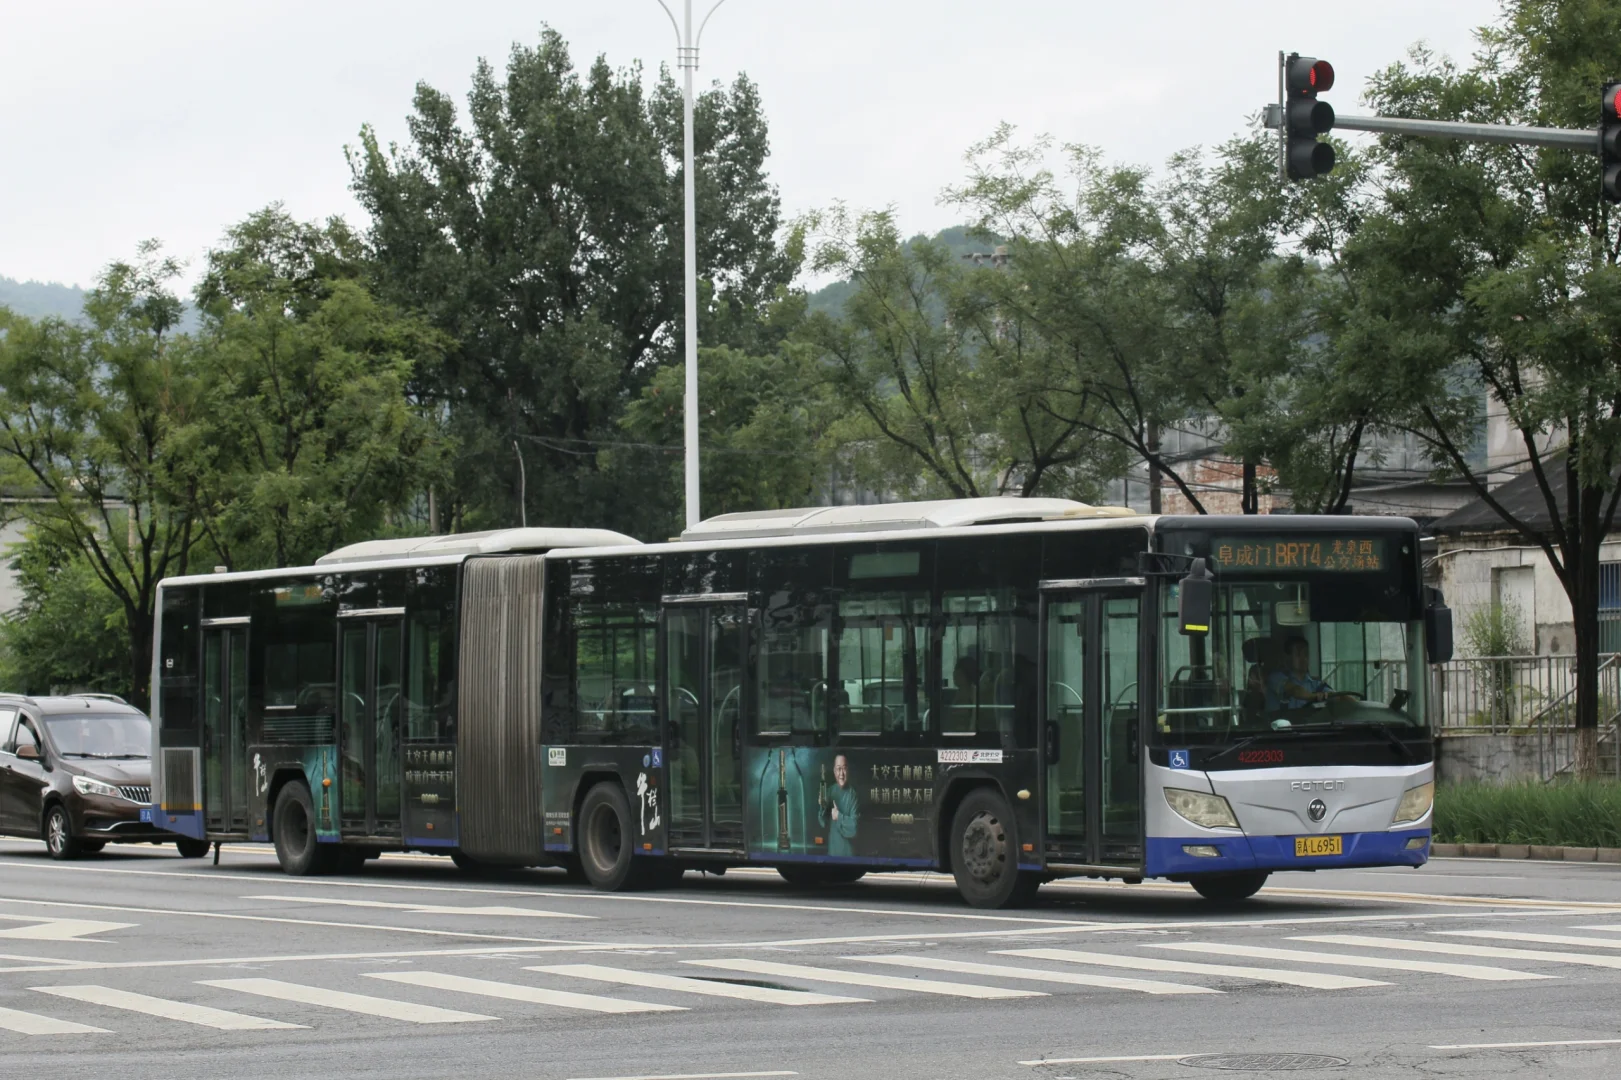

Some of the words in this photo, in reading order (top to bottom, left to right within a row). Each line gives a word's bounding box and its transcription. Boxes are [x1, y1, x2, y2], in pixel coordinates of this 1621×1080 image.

[1217, 544, 1271, 567] 阜成门
[1275, 542, 1321, 567] BRT4
[1323, 555, 1380, 571] 公交场站
[940, 750, 968, 762] 4222303
[1238, 750, 1284, 763] 4222303
[1291, 780, 1345, 792] FOTON
